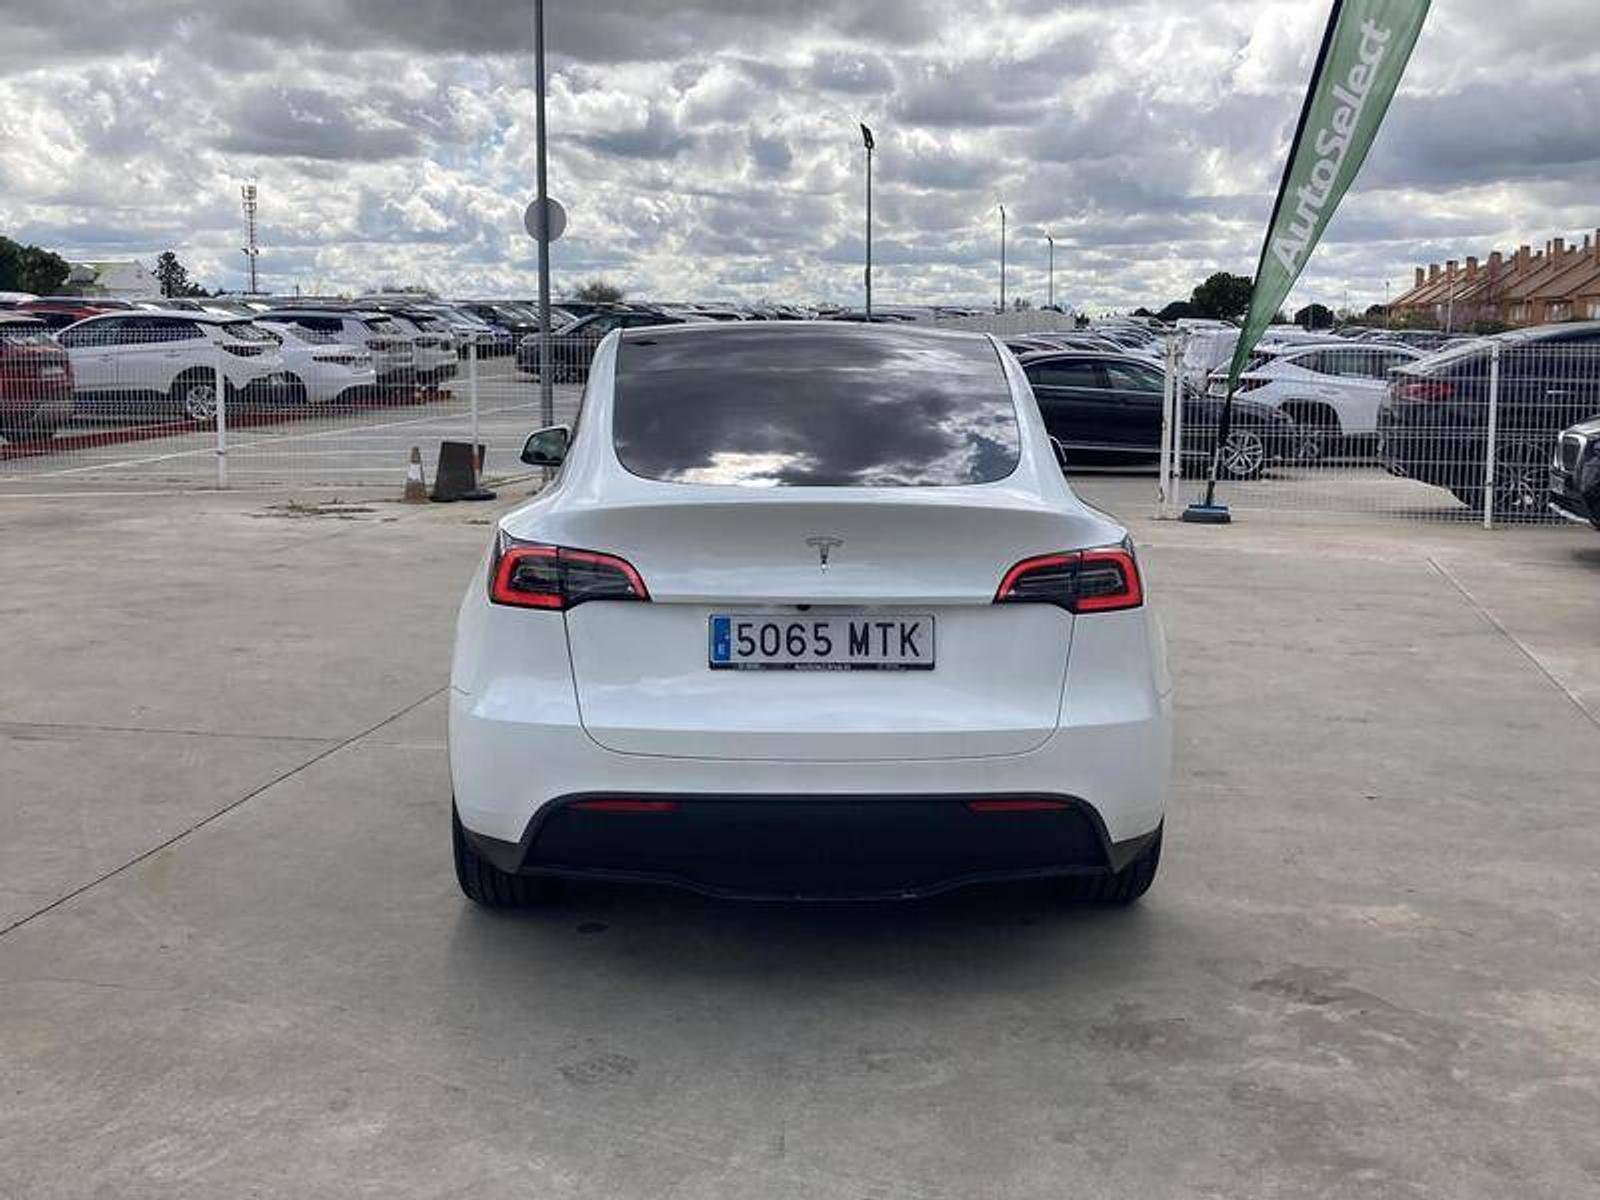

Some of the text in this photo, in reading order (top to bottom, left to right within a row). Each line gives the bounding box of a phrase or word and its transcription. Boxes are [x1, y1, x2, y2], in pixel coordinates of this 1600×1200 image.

[1271, 17, 1391, 277] AutoSelect
[737, 622, 920, 657] 5065 MTK
